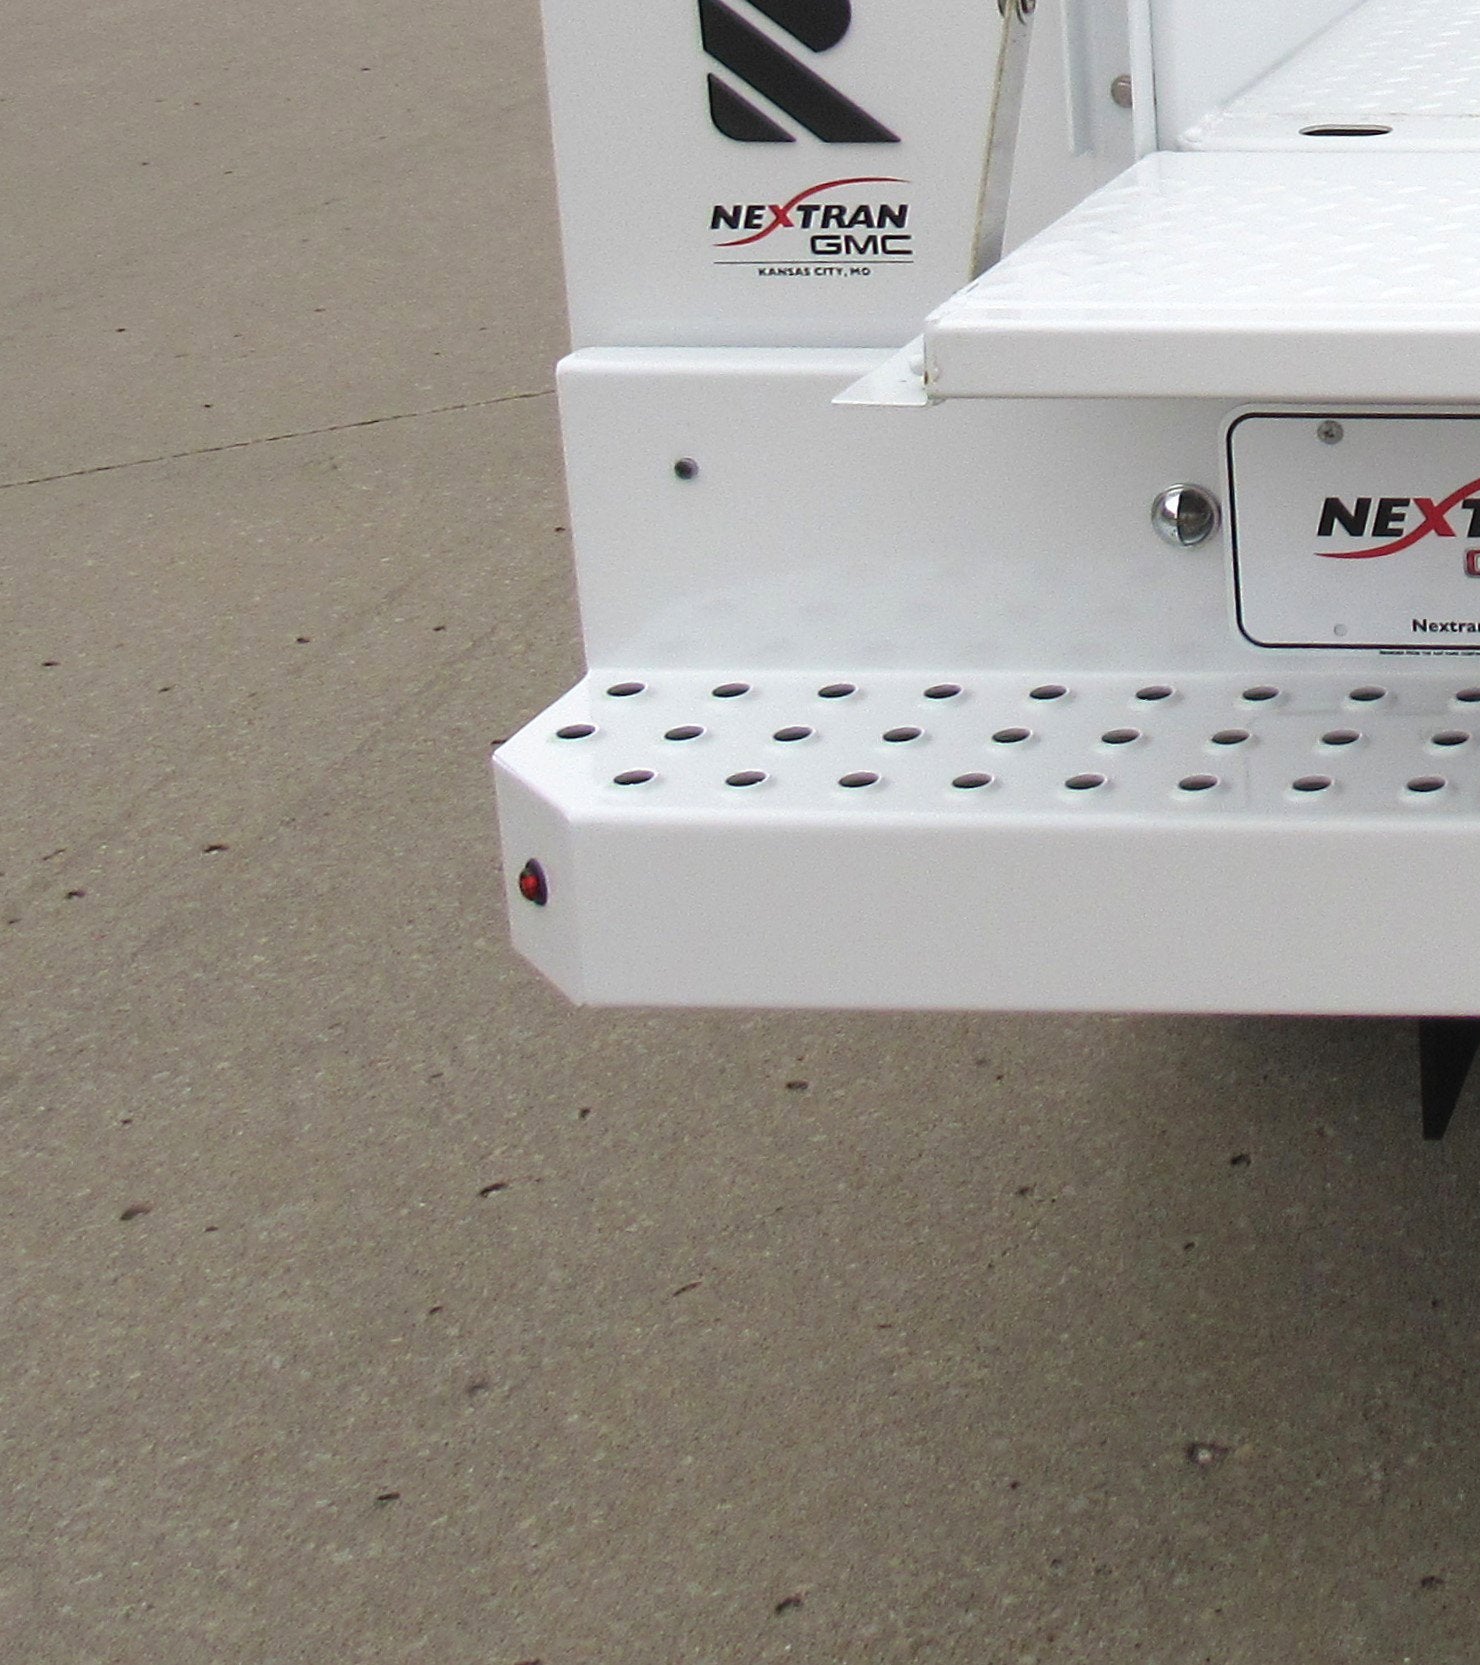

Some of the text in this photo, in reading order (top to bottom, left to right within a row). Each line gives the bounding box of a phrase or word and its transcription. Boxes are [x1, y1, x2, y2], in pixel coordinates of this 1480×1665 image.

[710, 203, 909, 229] NEXTRAN
[810, 235, 913, 255] GMC
[757, 267, 872, 278] KANSAS CITY, MO
